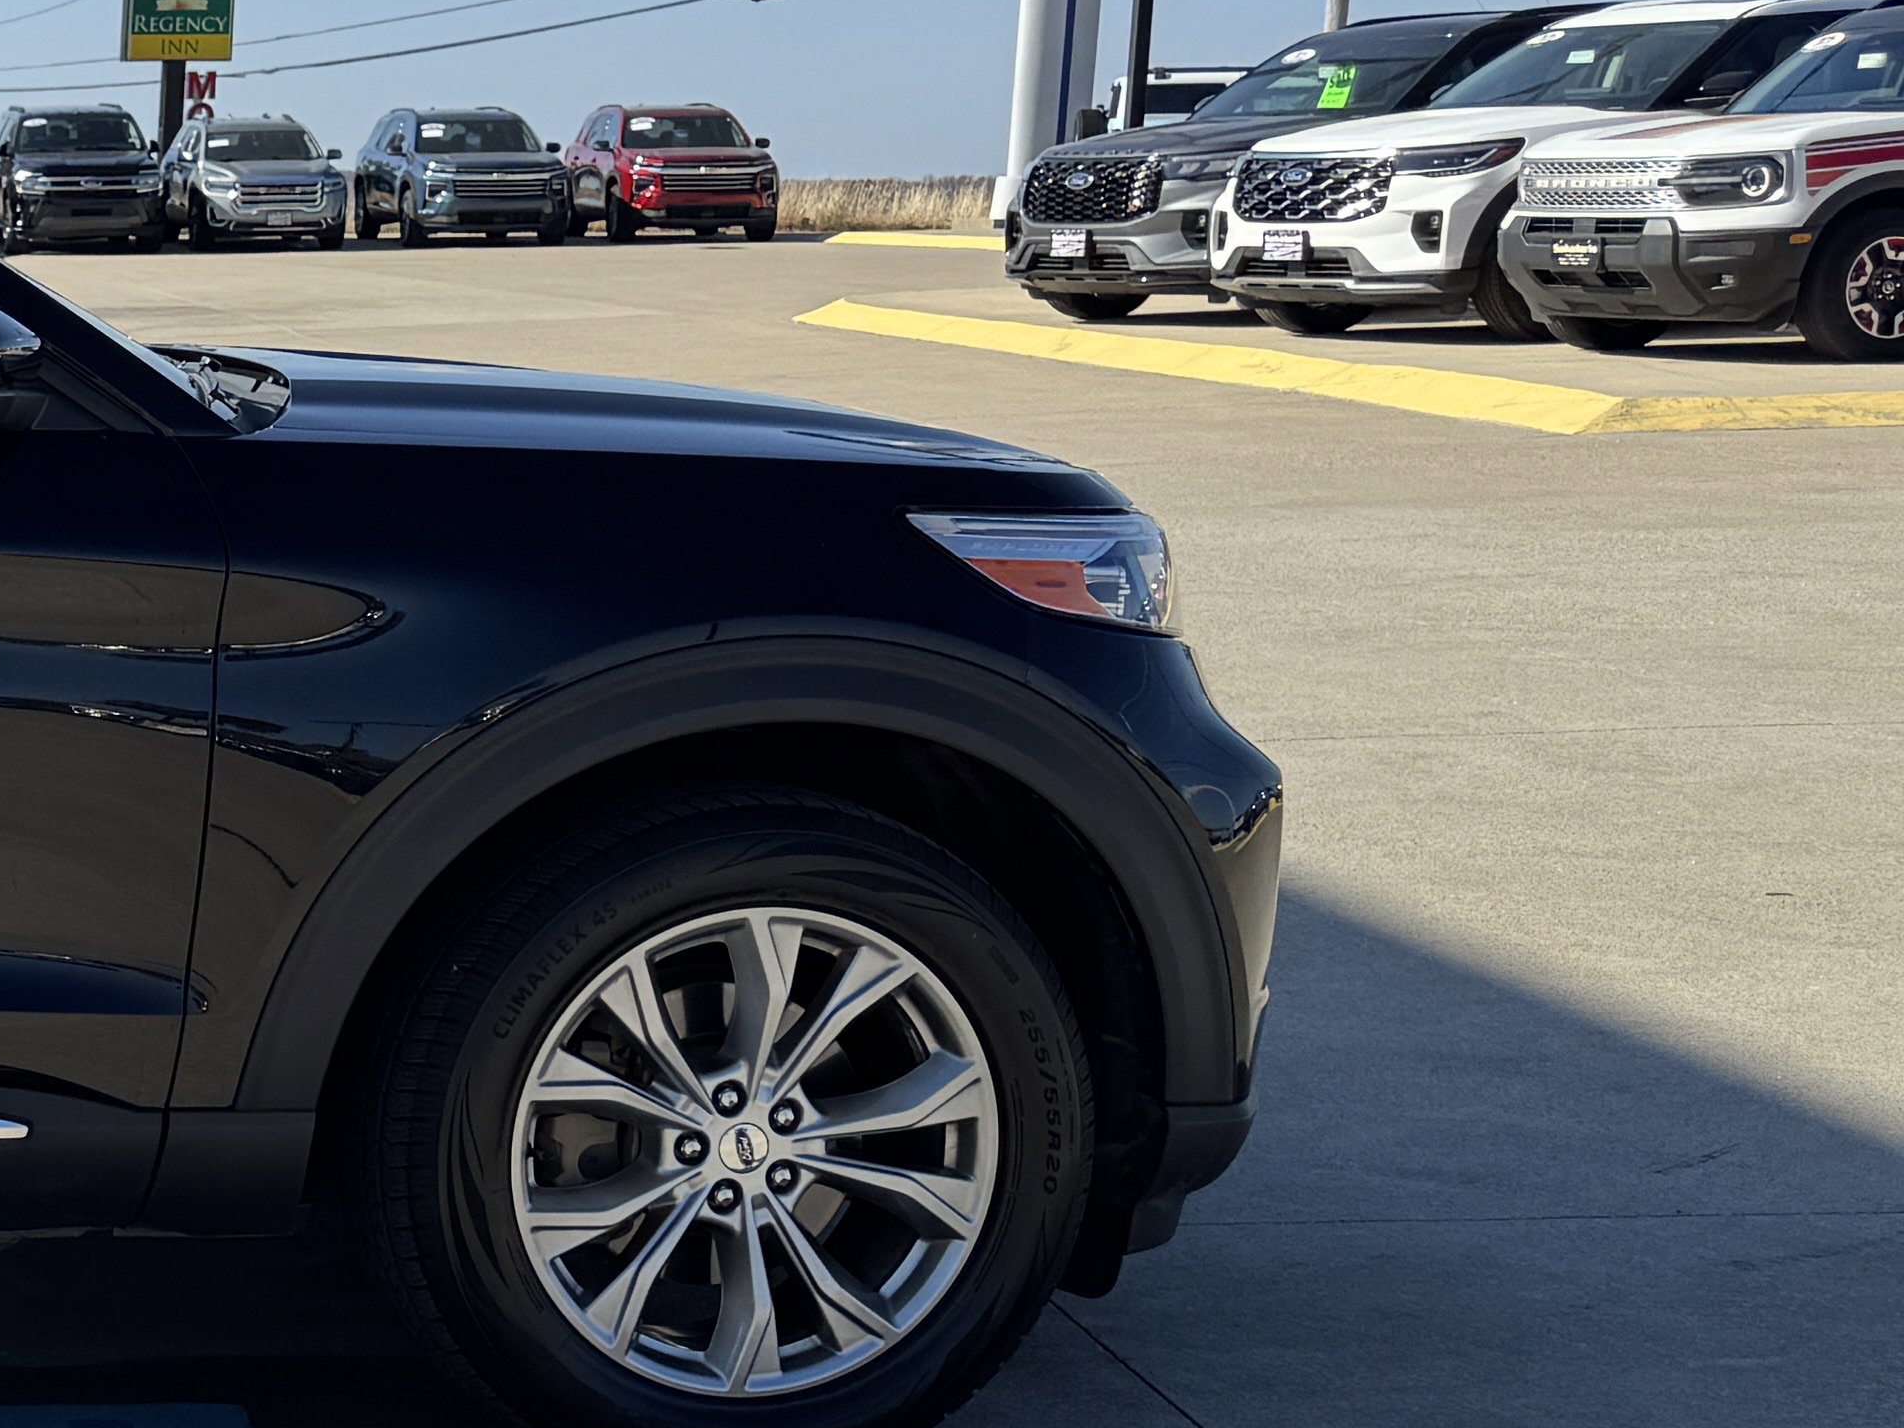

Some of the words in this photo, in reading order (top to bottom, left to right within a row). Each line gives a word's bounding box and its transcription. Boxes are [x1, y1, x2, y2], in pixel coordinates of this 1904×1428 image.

[134, 15, 228, 33] REGENCY
[161, 39, 199, 55] INN
[493, 923, 588, 1040] CLIMAFLEX
[1019, 1008, 1062, 1195] 255/55R20
